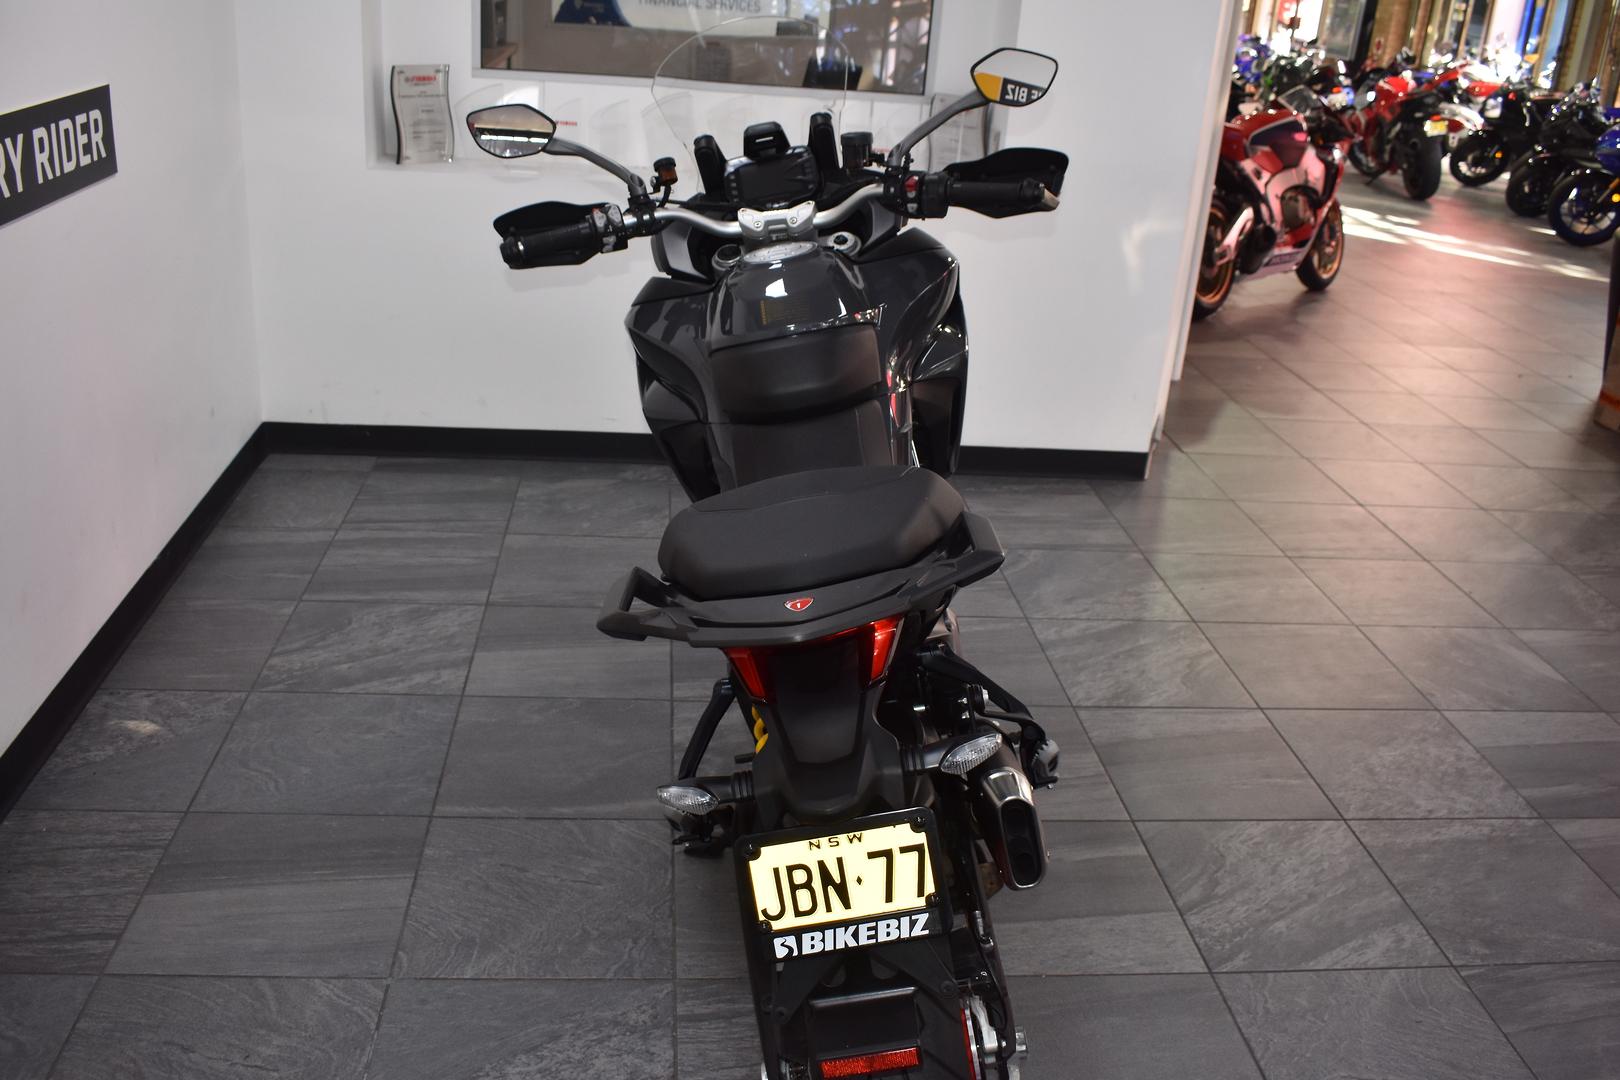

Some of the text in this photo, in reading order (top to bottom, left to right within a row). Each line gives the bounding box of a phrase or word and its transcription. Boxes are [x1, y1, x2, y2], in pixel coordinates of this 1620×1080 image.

[32, 108, 107, 185] RIDER
[808, 832, 863, 851] NSW
[760, 842, 926, 921] JBN 77
[801, 912, 930, 955] BIKEBIZ
